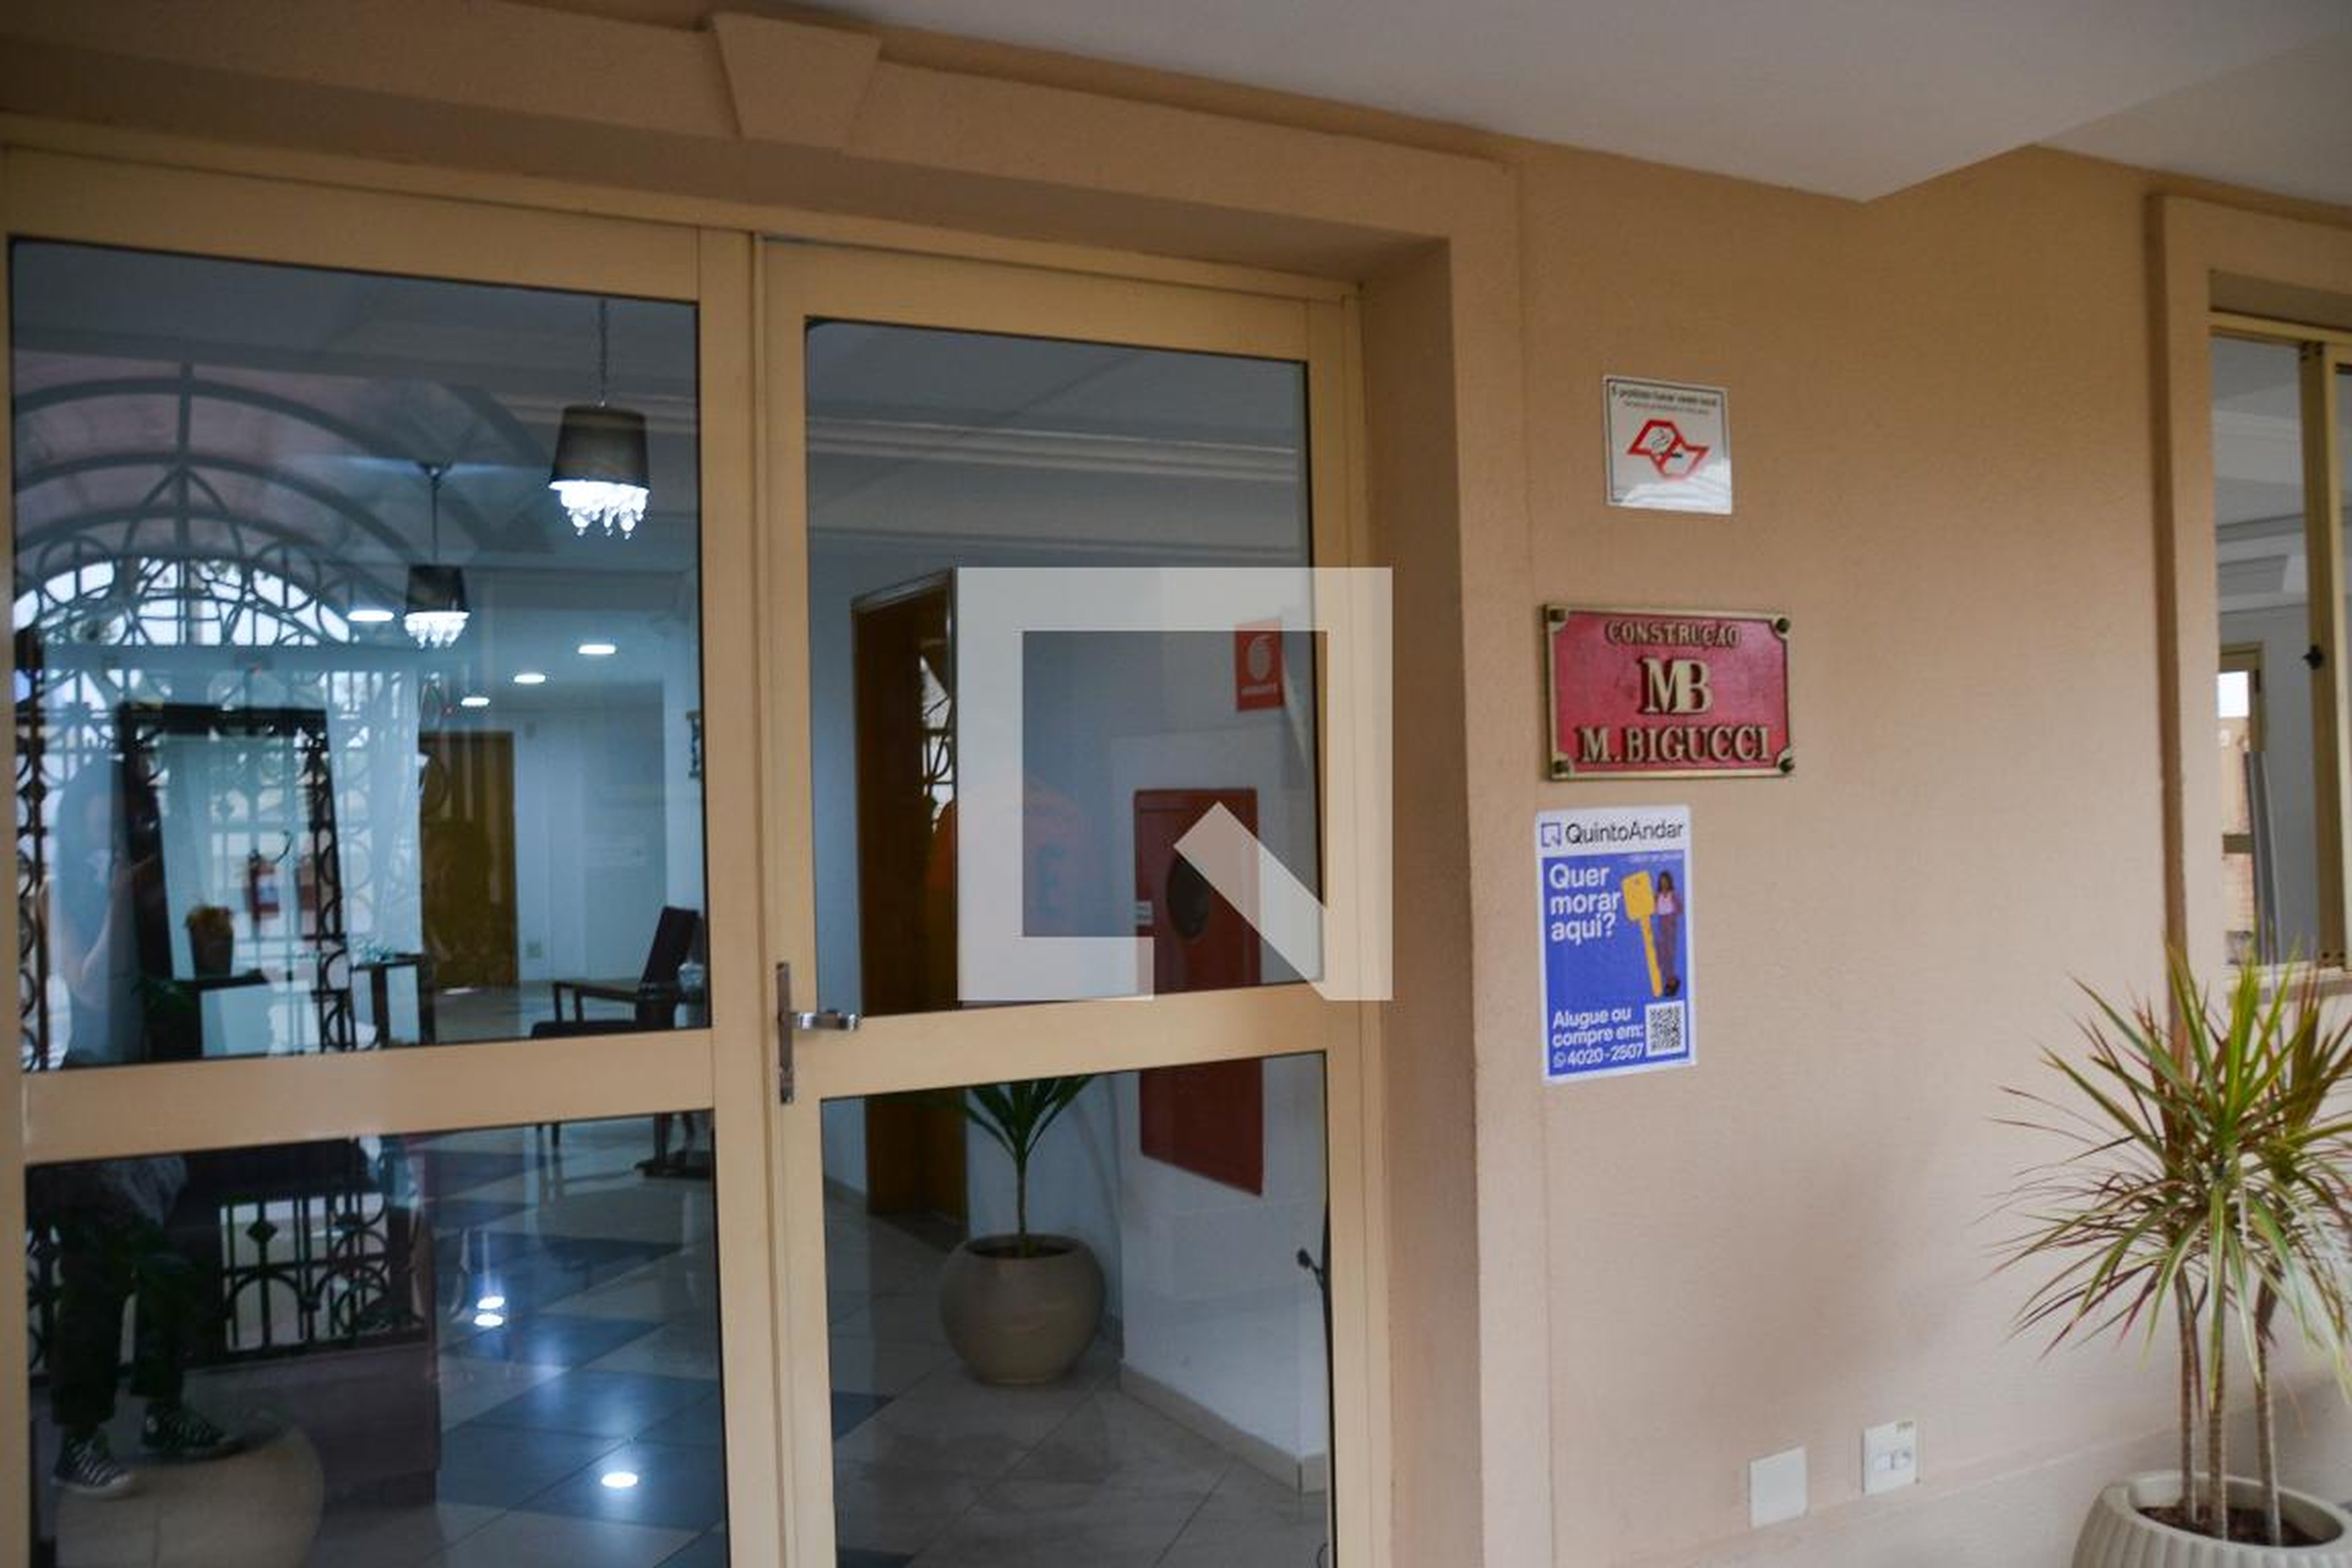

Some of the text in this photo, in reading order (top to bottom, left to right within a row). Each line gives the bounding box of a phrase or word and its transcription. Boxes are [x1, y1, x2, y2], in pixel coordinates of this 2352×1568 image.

[1640, 657, 1713, 714] MB
[1623, 724, 1771, 763] BIGUCCI
[1566, 821, 1683, 844] QuintoAndar
[1549, 863, 1610, 888] Quer
[1550, 891, 1621, 915] morar
[1551, 912, 1617, 946] aqui?
[1553, 1008, 1631, 1030] Alugue ou
[1553, 1024, 1644, 1047] compre em:
